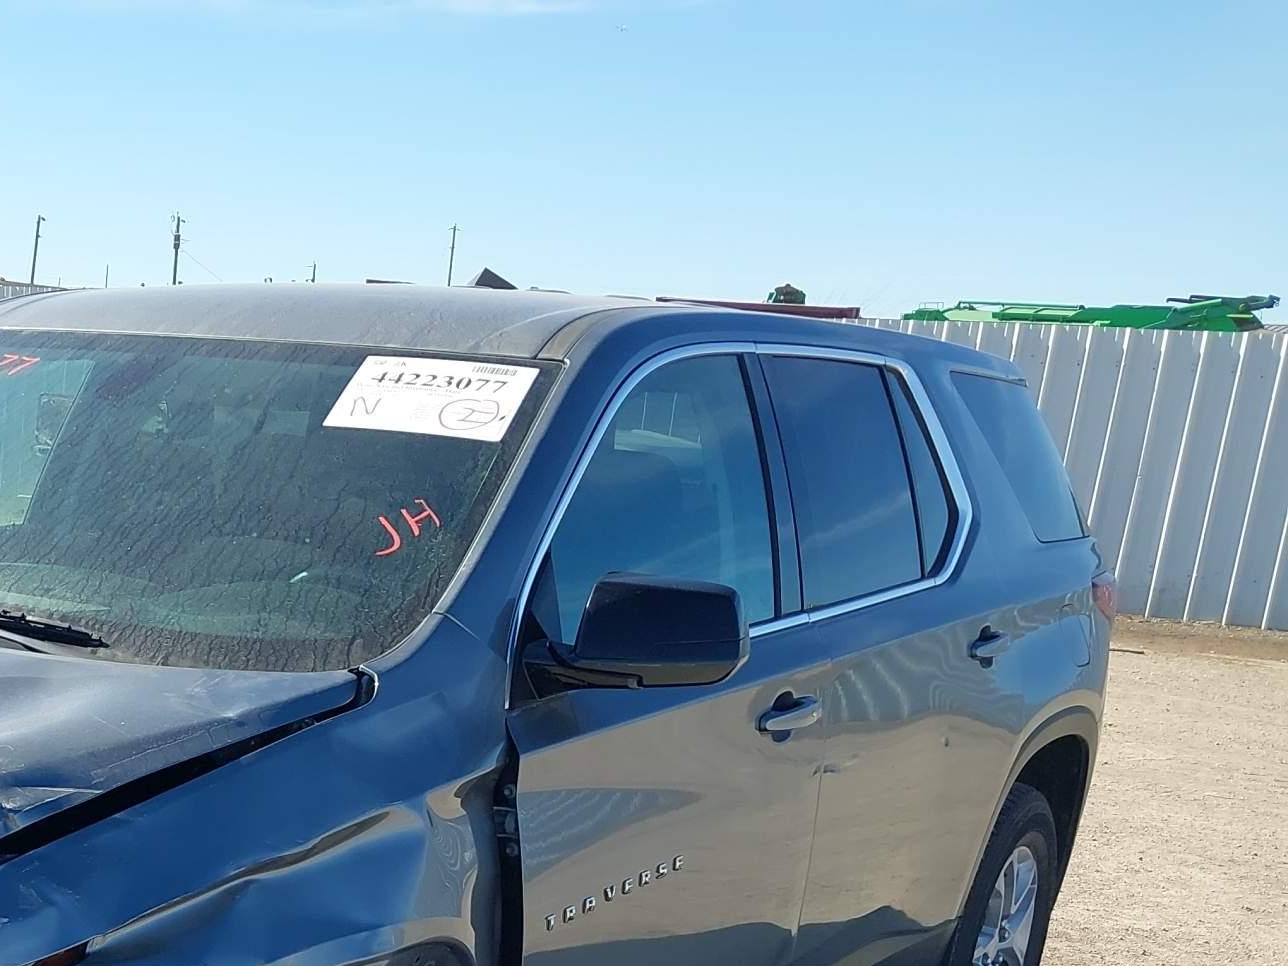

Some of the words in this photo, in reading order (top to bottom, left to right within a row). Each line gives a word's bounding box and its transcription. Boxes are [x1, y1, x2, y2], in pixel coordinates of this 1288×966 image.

[370, 371, 509, 394] 44223077
[350, 396, 382, 417] N
[544, 855, 685, 931] TRAVERSE
